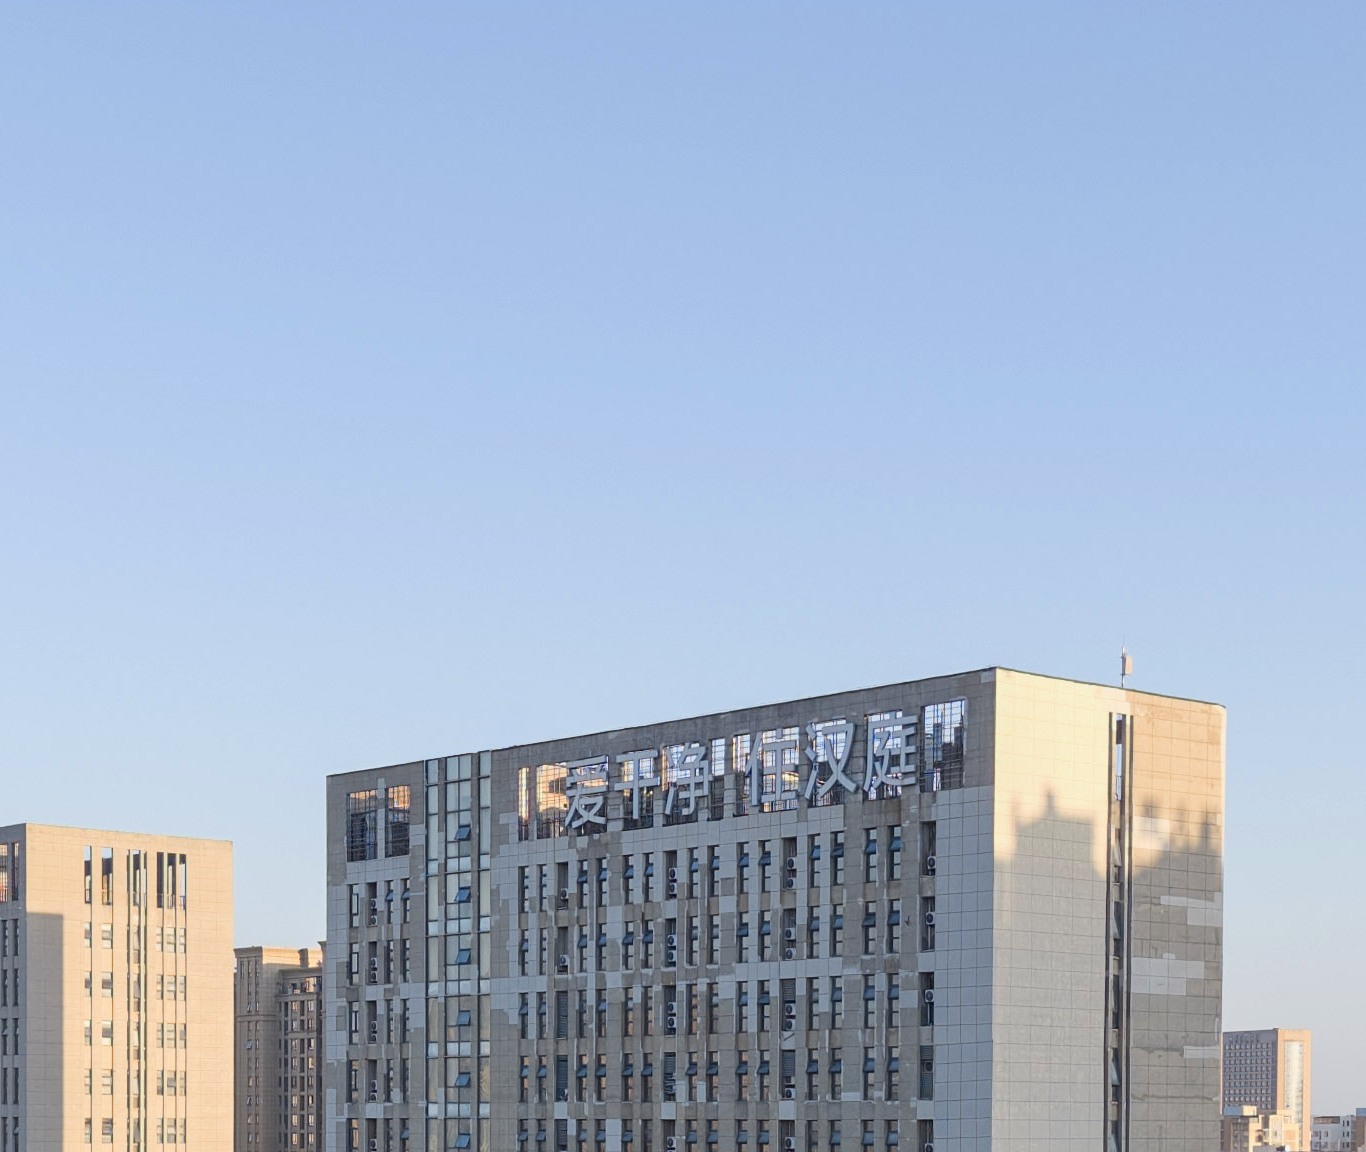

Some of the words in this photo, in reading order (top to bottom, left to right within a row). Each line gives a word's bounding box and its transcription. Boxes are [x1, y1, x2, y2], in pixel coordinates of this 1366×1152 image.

[563, 740, 710, 828] 爱干净
[747, 712, 919, 808] 住汉庭
